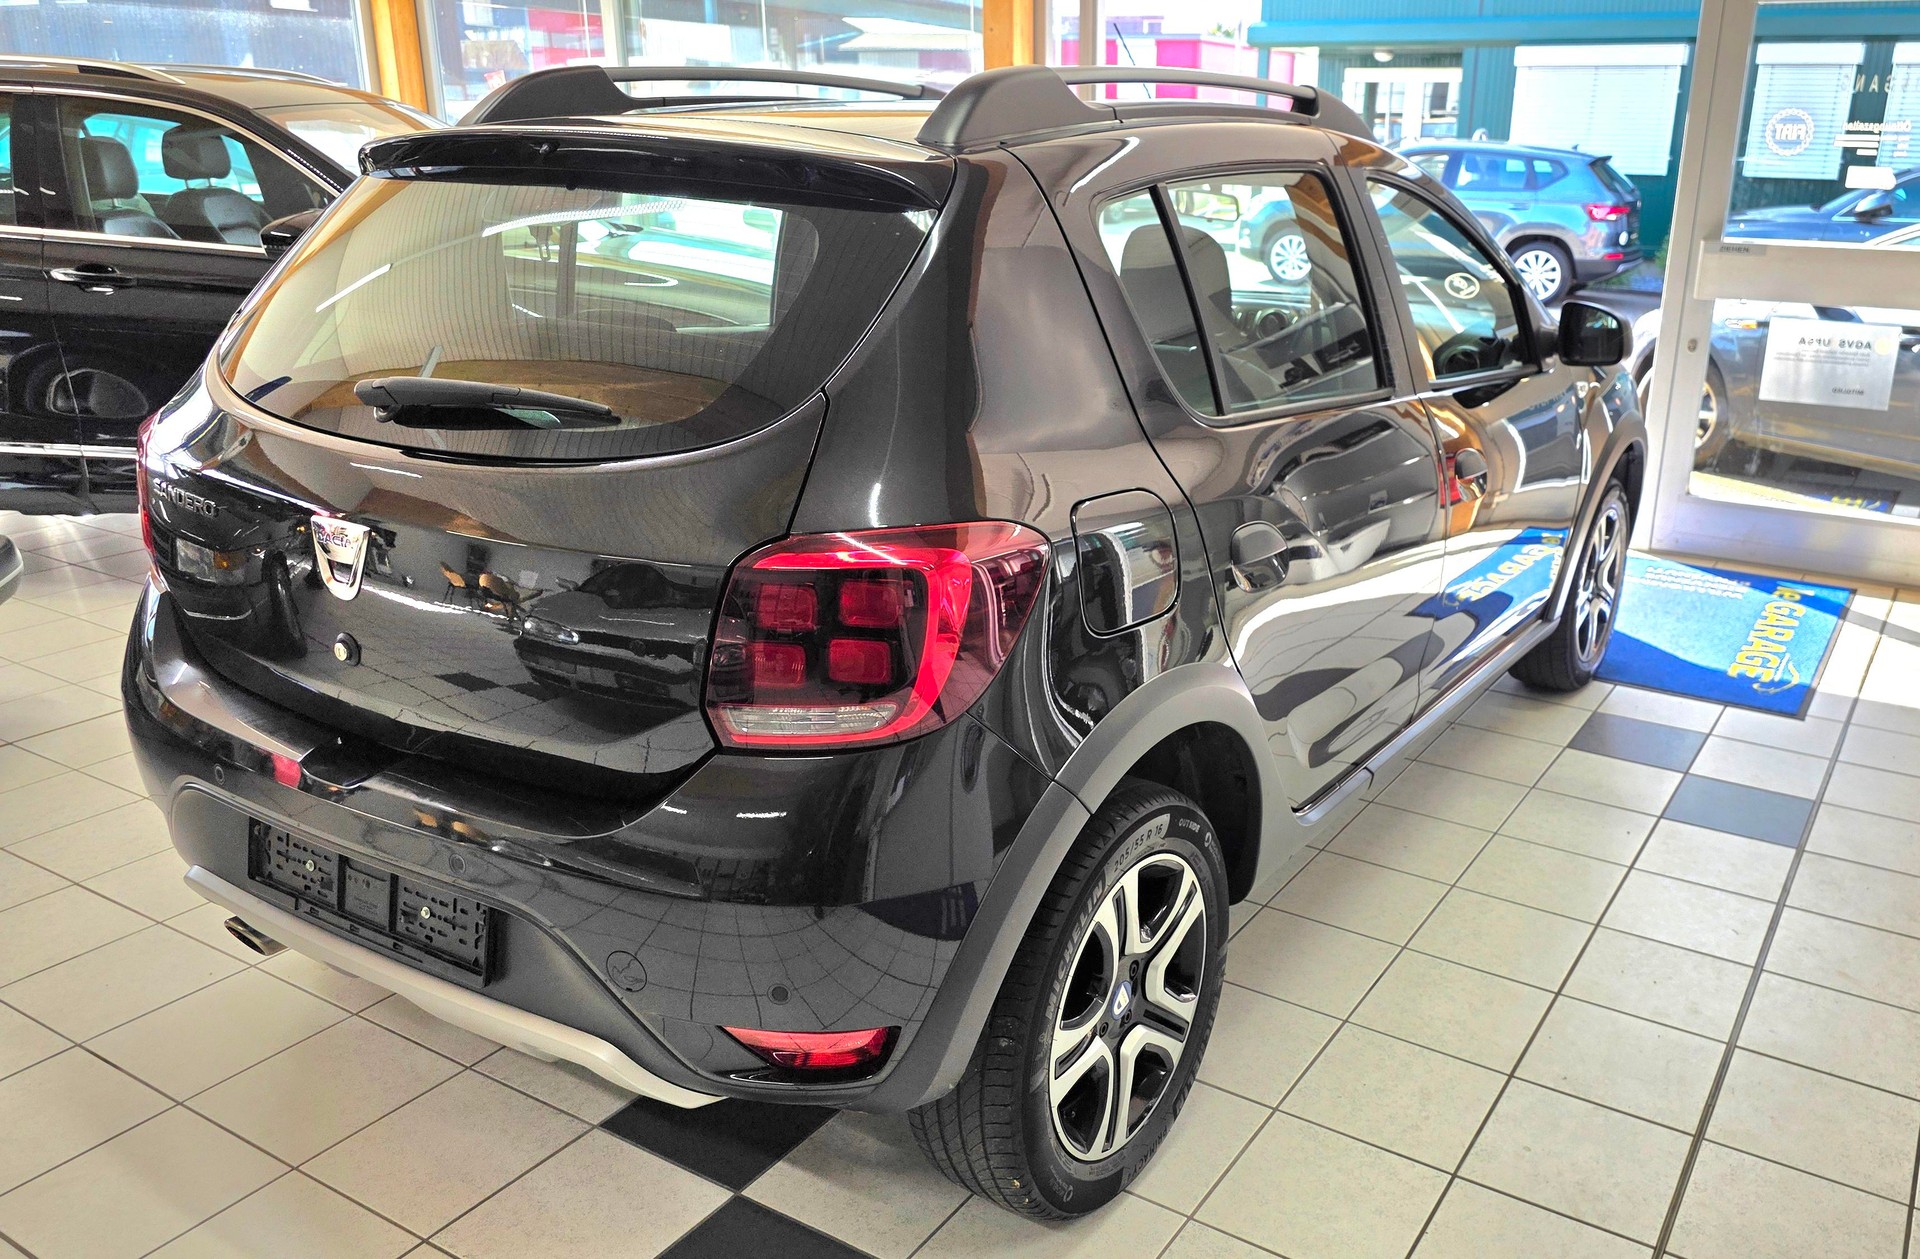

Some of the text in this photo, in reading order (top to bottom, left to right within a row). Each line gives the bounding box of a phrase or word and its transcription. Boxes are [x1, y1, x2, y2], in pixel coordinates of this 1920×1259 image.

[153, 478, 216, 517] SANDERO
[1772, 585, 1816, 602] le
[1727, 601, 1807, 683] GARAGE
[1114, 833, 1145, 872] 205/55
[1146, 829, 1153, 841] R
[1154, 823, 1163, 837] 16
[1178, 818, 1201, 834] OUTSIDE
[1045, 879, 1103, 1020] MICHELIN
